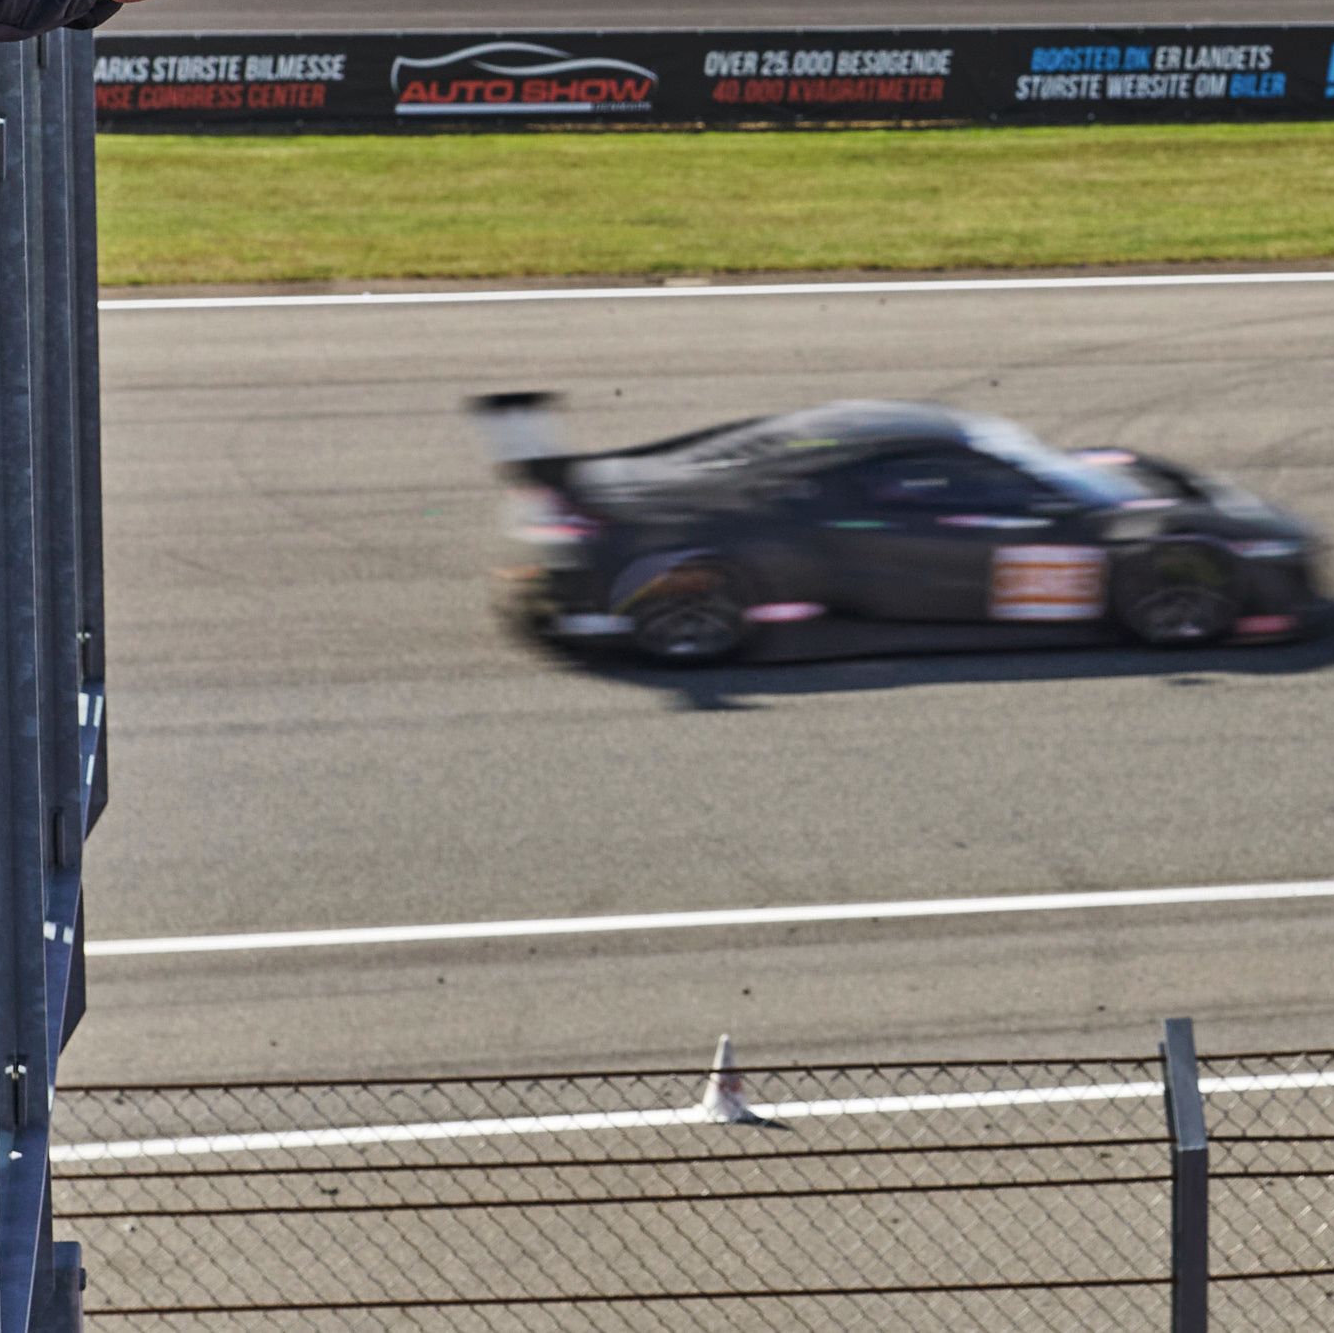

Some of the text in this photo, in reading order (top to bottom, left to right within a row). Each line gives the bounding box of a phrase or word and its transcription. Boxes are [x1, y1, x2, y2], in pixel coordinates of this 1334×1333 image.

[94, 55, 150, 82] ARKS
[244, 54, 347, 81] BILMESSE
[704, 50, 759, 77] OVER
[760, 50, 834, 77] 25.000
[1154, 45, 1182, 71] ER
[1184, 45, 1273, 71] LANDETS
[138, 84, 244, 110] CONGRESS
[246, 83, 327, 109] CENTER
[399, 78, 653, 103] AUTO SHOW
[1105, 73, 1194, 100] WEBSITE
[1194, 73, 1228, 99] OM
[1229, 72, 1287, 98] BILER
